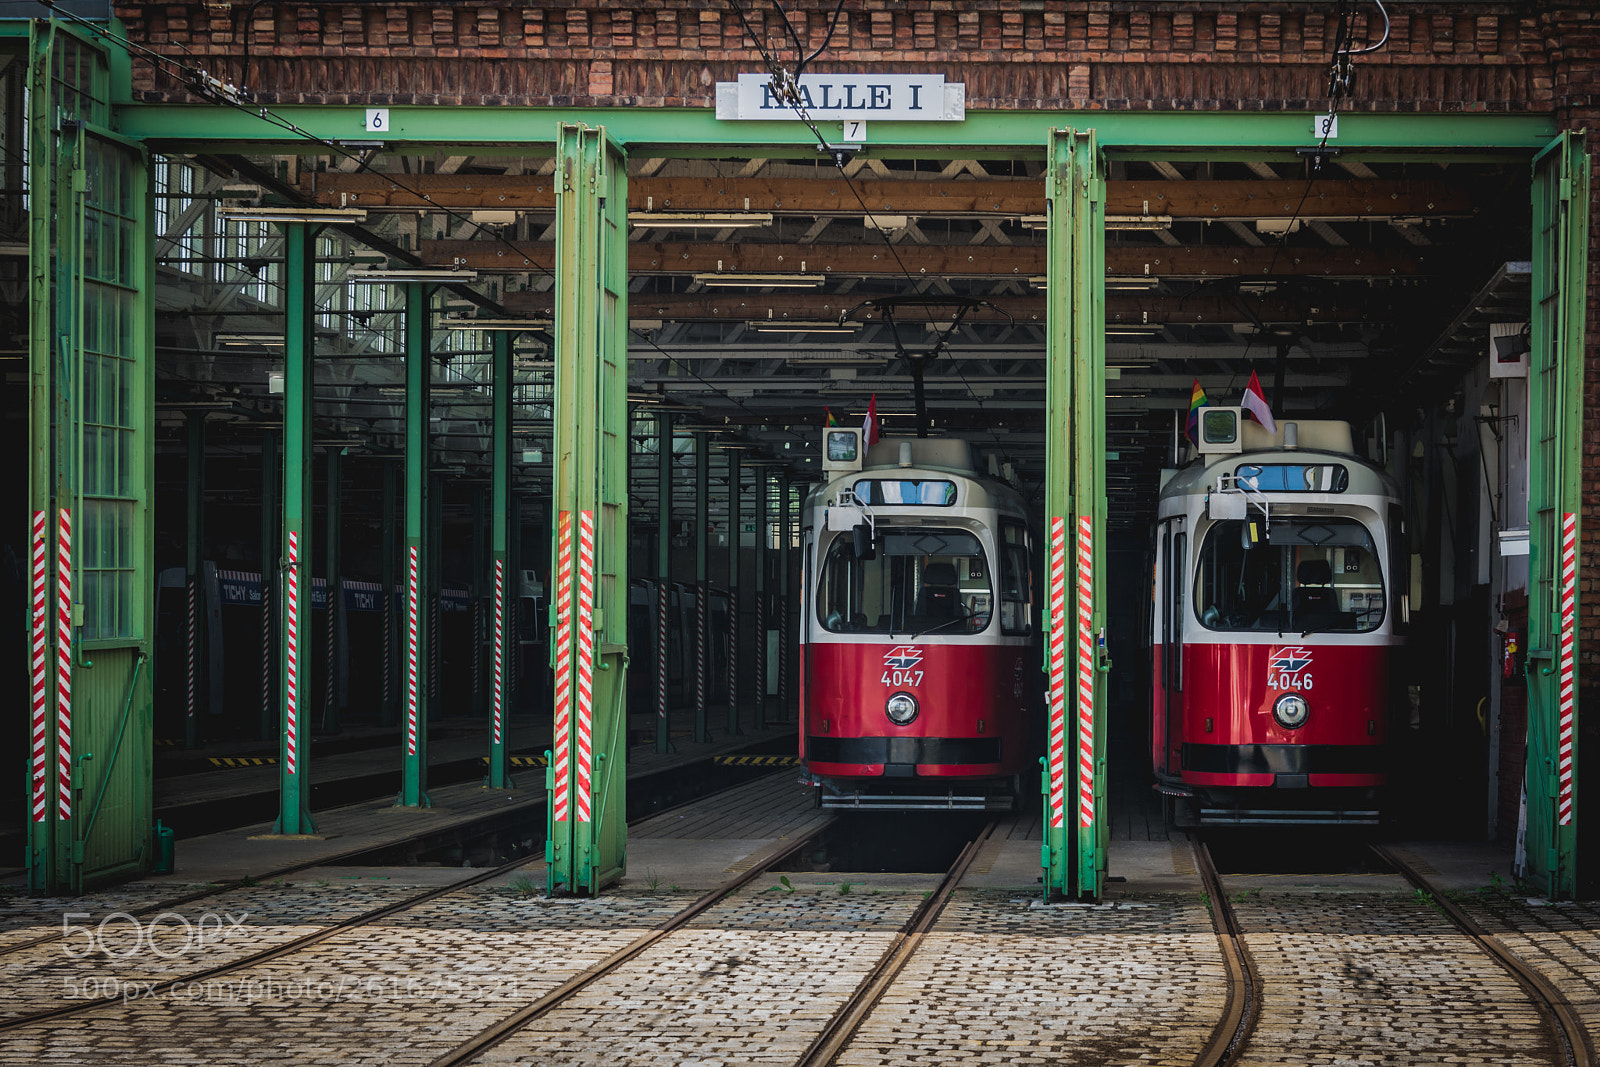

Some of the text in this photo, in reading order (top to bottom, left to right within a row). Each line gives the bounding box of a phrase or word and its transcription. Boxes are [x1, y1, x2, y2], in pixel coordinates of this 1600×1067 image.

[759, 84, 923, 110] HALLE I
[373, 112, 382, 128] 6
[1322, 118, 1331, 135] 8
[850, 121, 860, 138] 7
[223, 584, 246, 601] TICHY
[354, 592, 374, 609] TICHY
[881, 670, 924, 687] 4047
[1267, 673, 1313, 690] 4046
